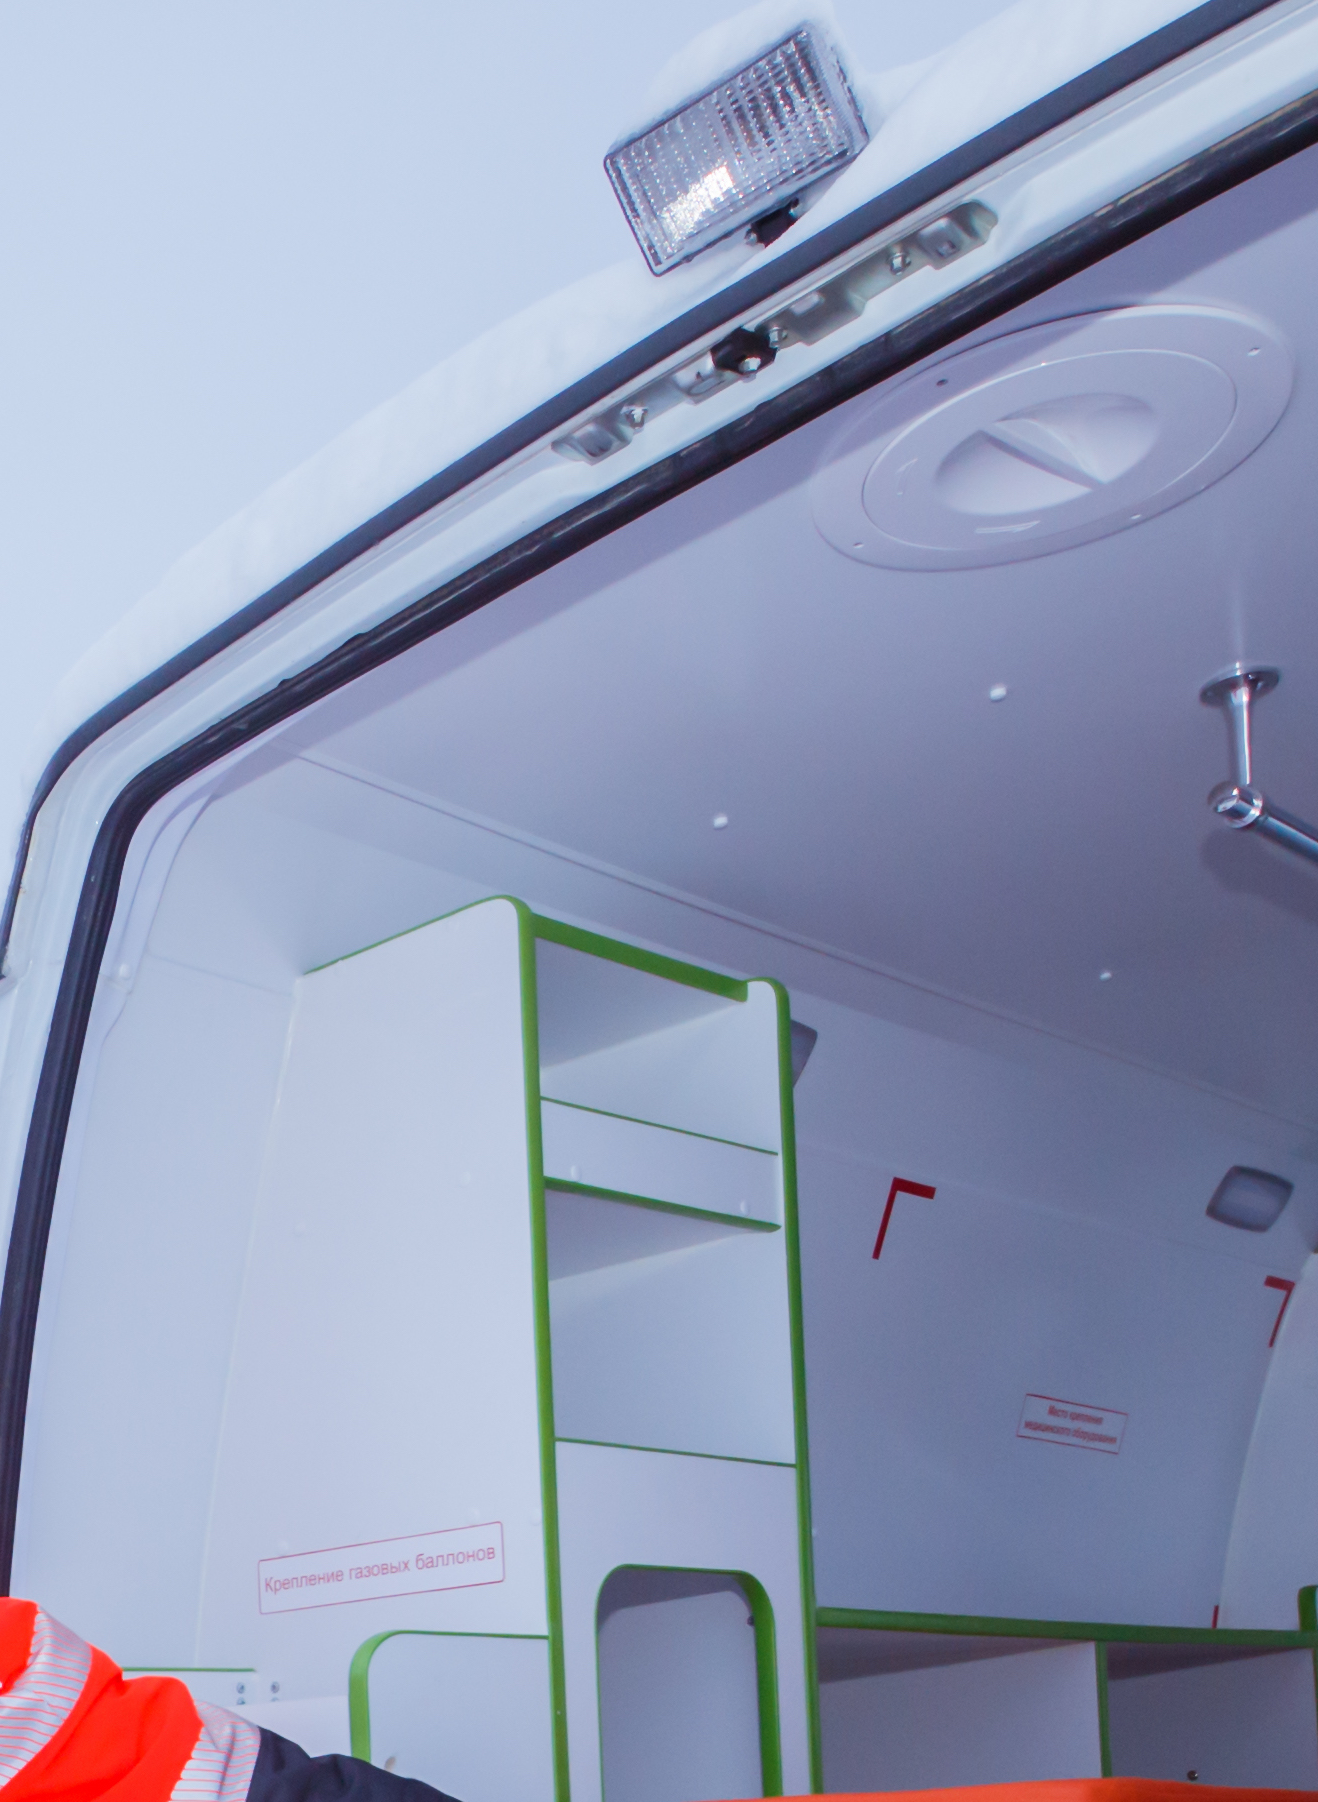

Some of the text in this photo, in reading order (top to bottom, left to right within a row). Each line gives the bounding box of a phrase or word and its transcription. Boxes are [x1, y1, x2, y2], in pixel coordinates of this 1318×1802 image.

[264, 1546, 496, 1595] Крепление газовых баллонов
